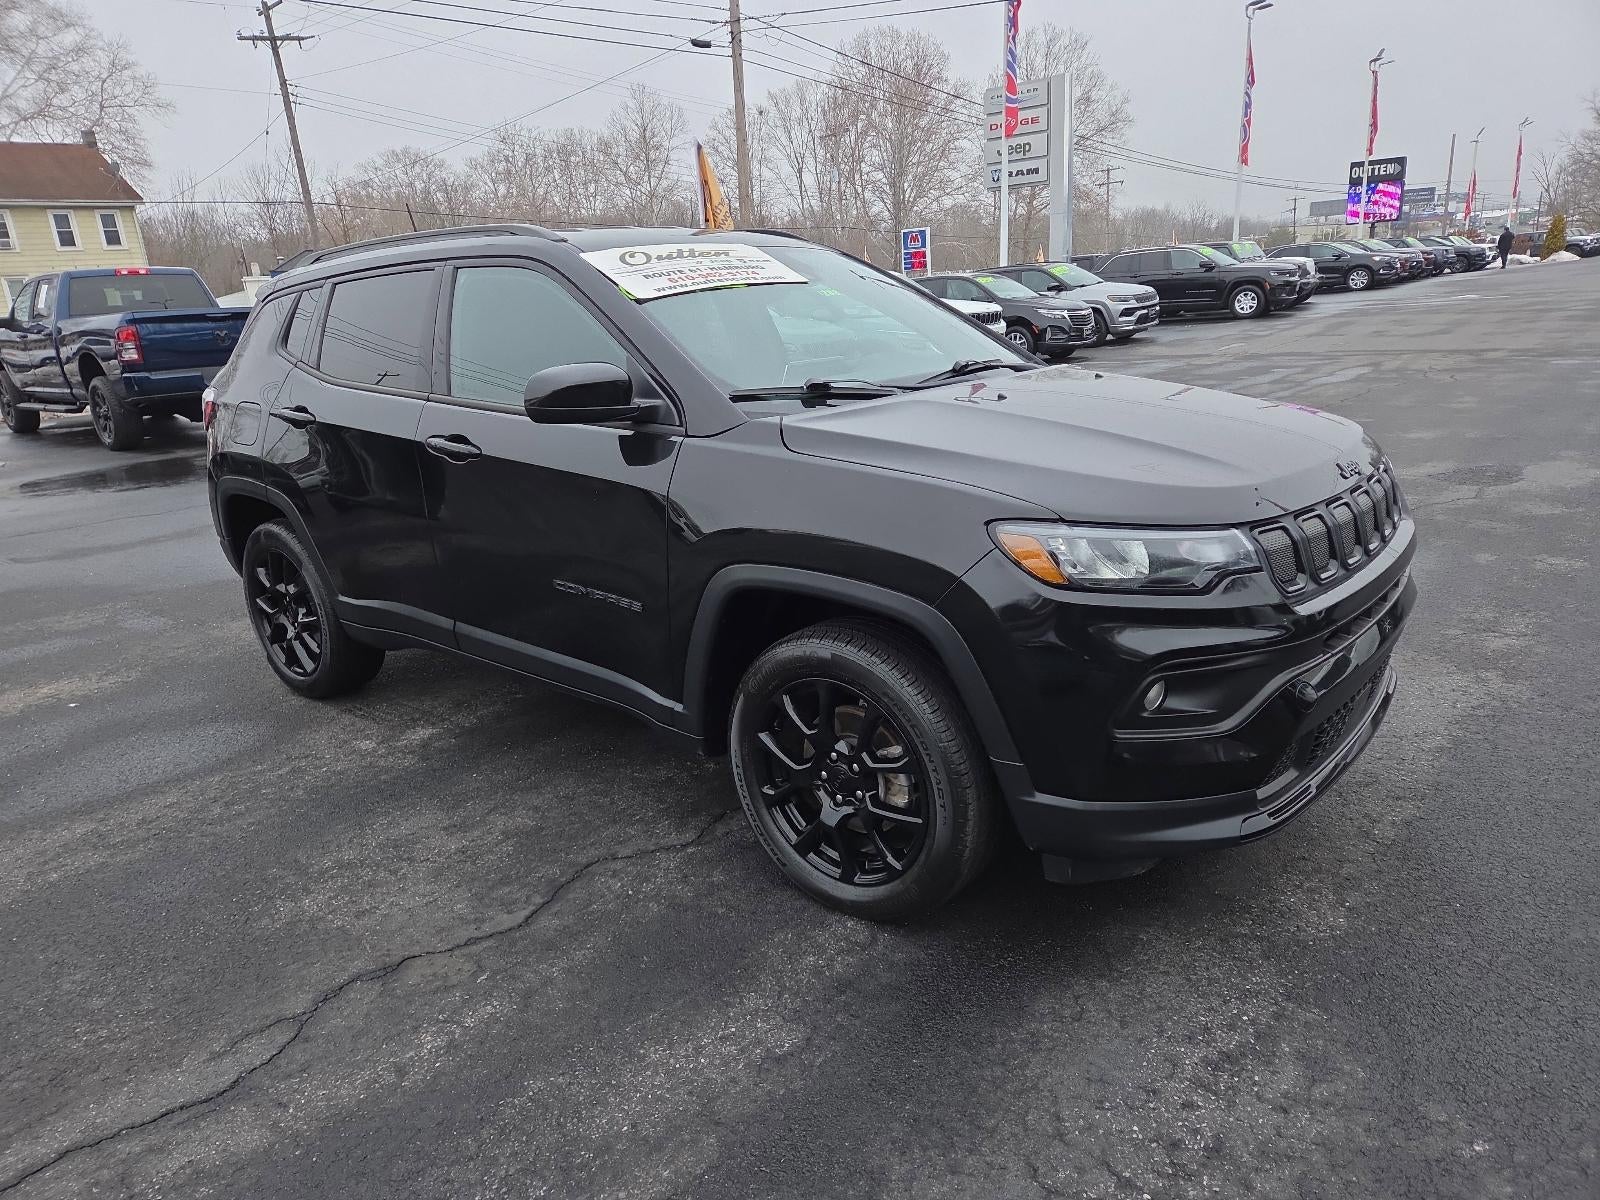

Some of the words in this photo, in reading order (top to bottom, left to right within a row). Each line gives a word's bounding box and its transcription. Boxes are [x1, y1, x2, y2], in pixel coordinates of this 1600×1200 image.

[990, 87, 1039, 100] CHLER
[989, 115, 1041, 131] DGE
[619, 248, 730, 266] Outten
[641, 268, 687, 280] ROUTE
[552, 578, 643, 613] COMPASS
